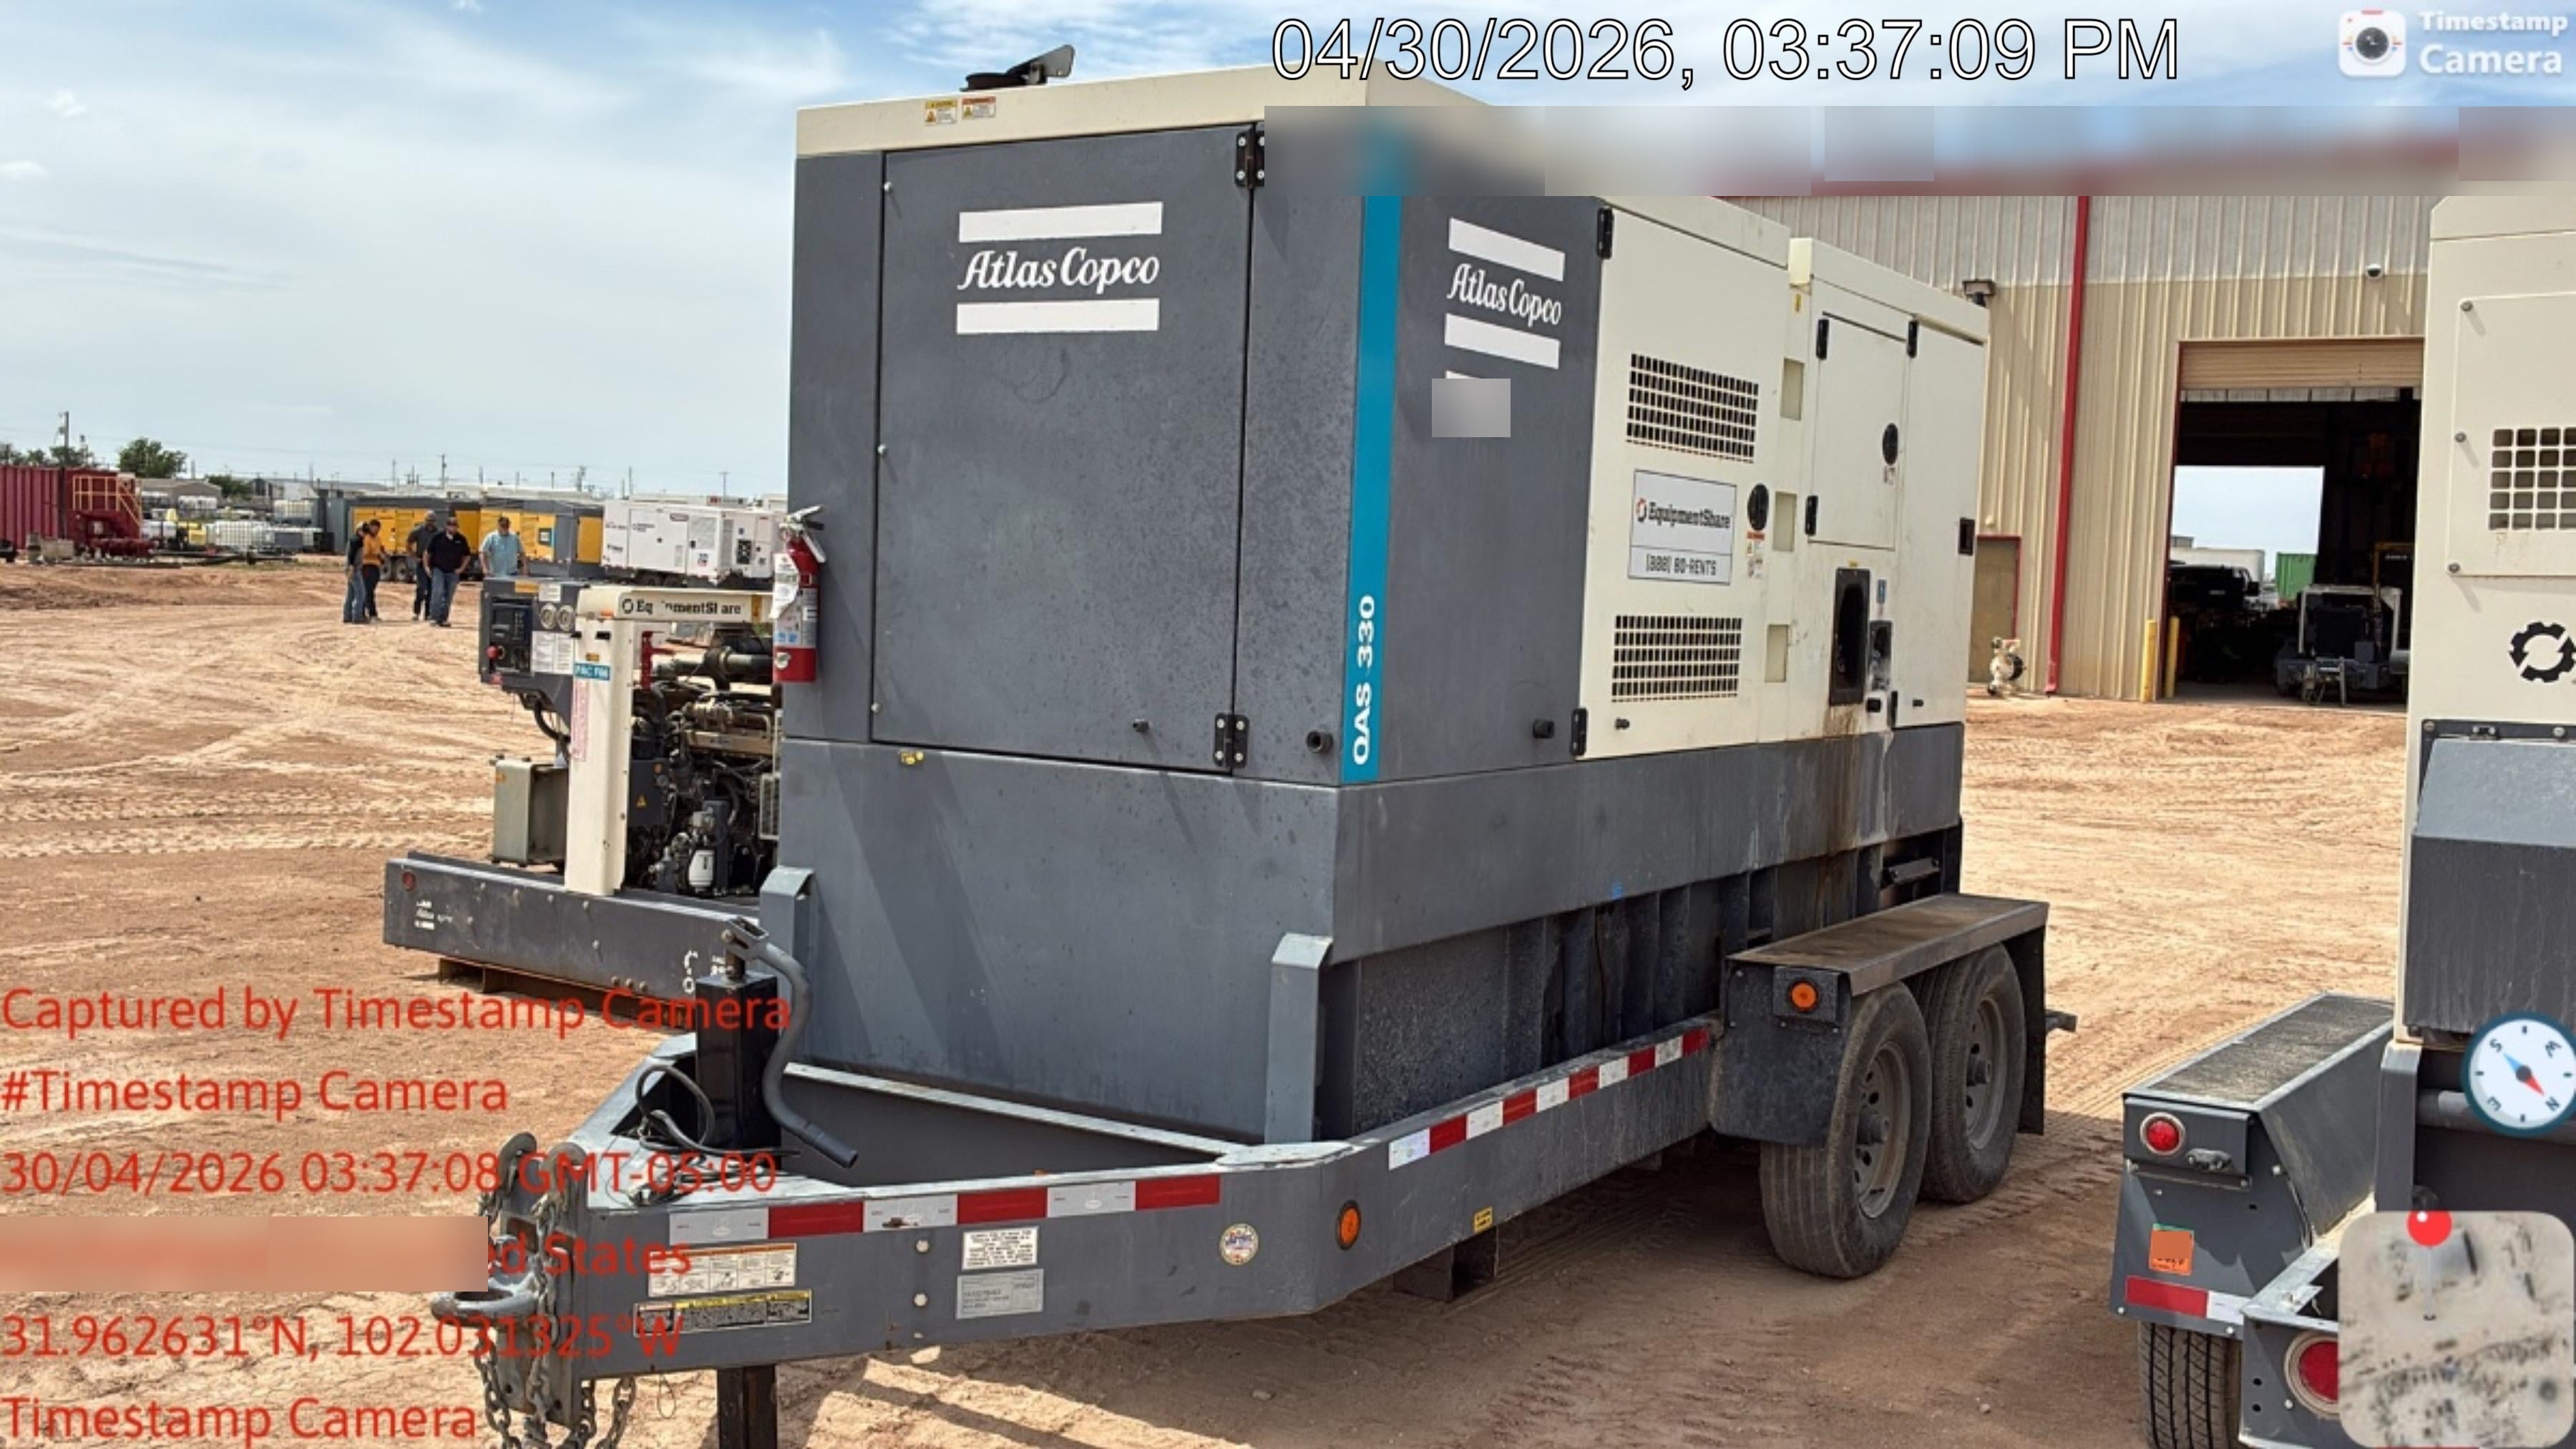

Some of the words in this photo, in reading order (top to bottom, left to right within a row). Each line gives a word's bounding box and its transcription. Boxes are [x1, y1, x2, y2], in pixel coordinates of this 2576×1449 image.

[957, 250, 1057, 291] Atlas
[1060, 246, 1160, 295] Copco
[1446, 263, 1508, 312] Atlas
[1508, 278, 1562, 328] Copco
[1648, 501, 1730, 530] EquipmentShare
[637, 600, 742, 615] EqmentSare
[1357, 594, 1375, 668] 330
[1352, 681, 1372, 766] QAS
